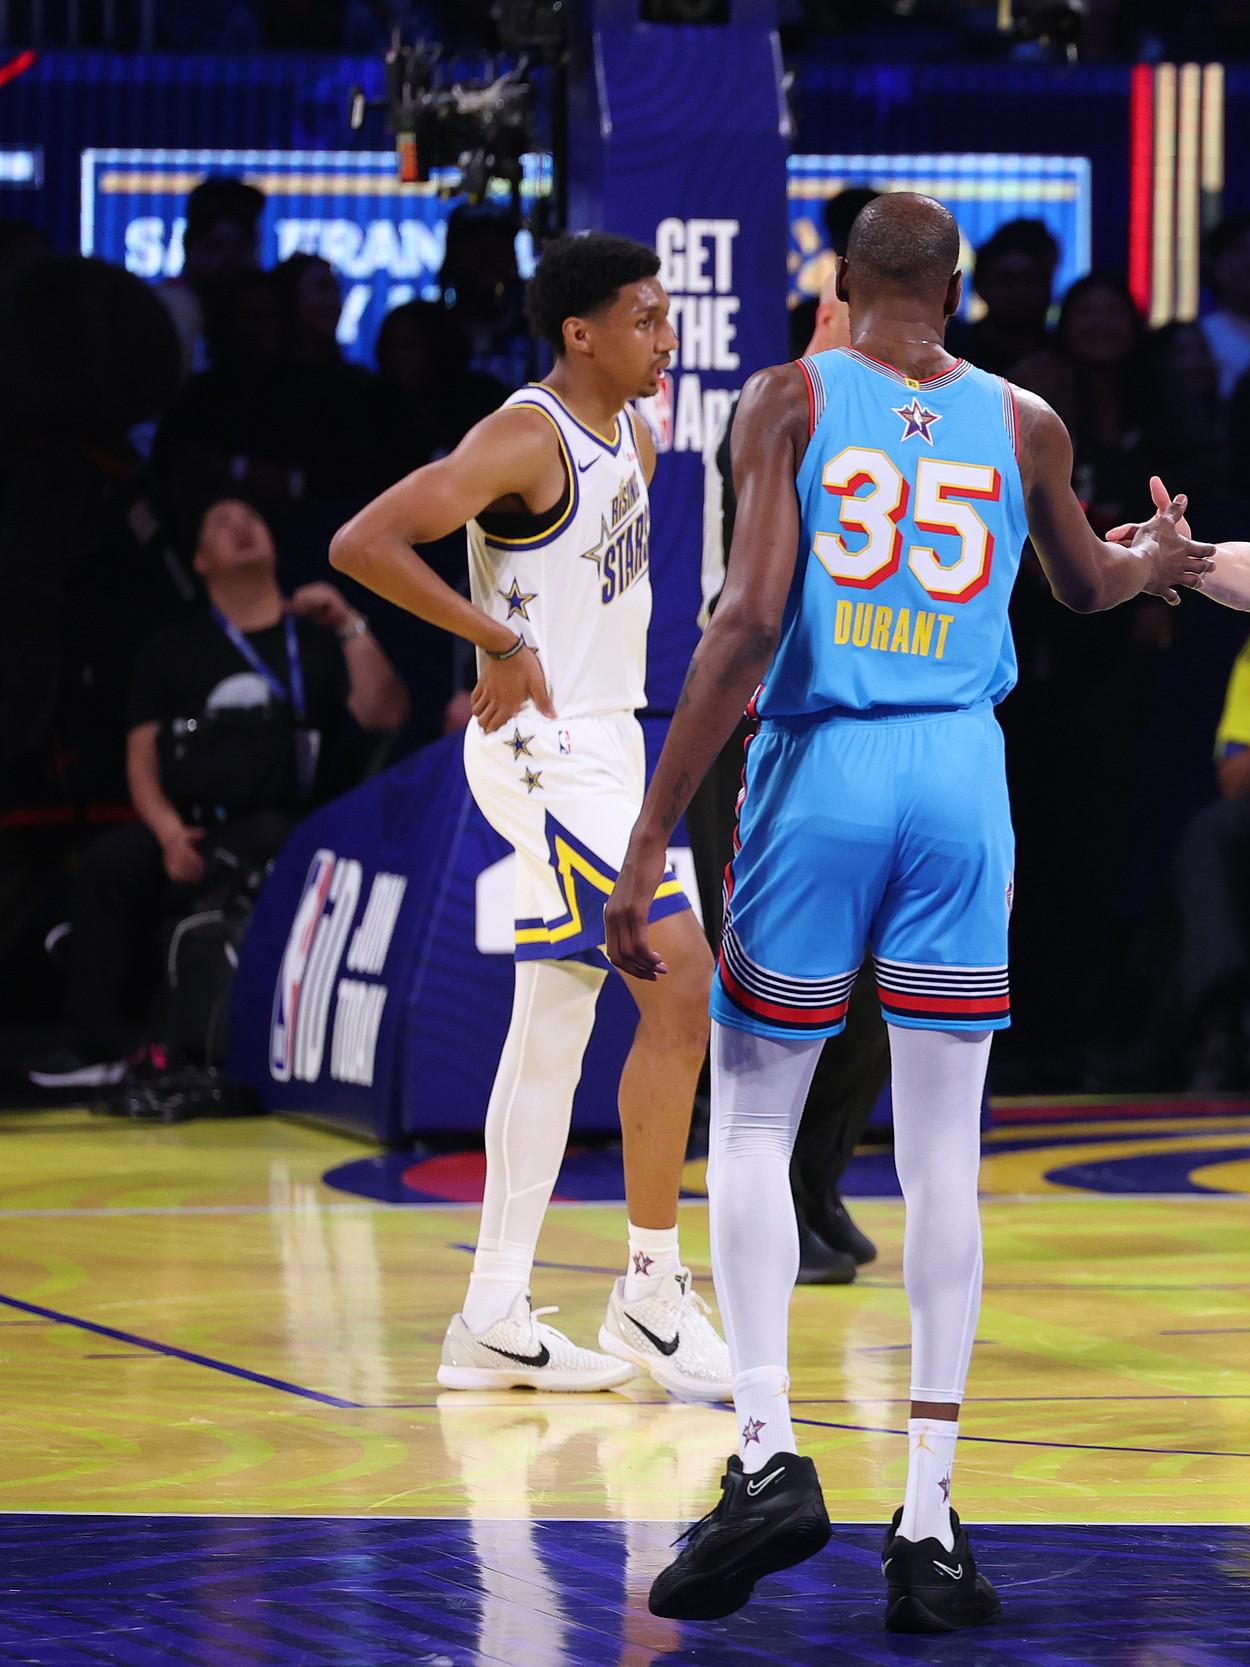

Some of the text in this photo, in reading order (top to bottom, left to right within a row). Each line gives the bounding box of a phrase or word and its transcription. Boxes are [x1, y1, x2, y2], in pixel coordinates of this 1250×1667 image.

[656, 217, 741, 293] GET
[812, 445, 1002, 604] 35
[834, 600, 955, 659] DURANT
